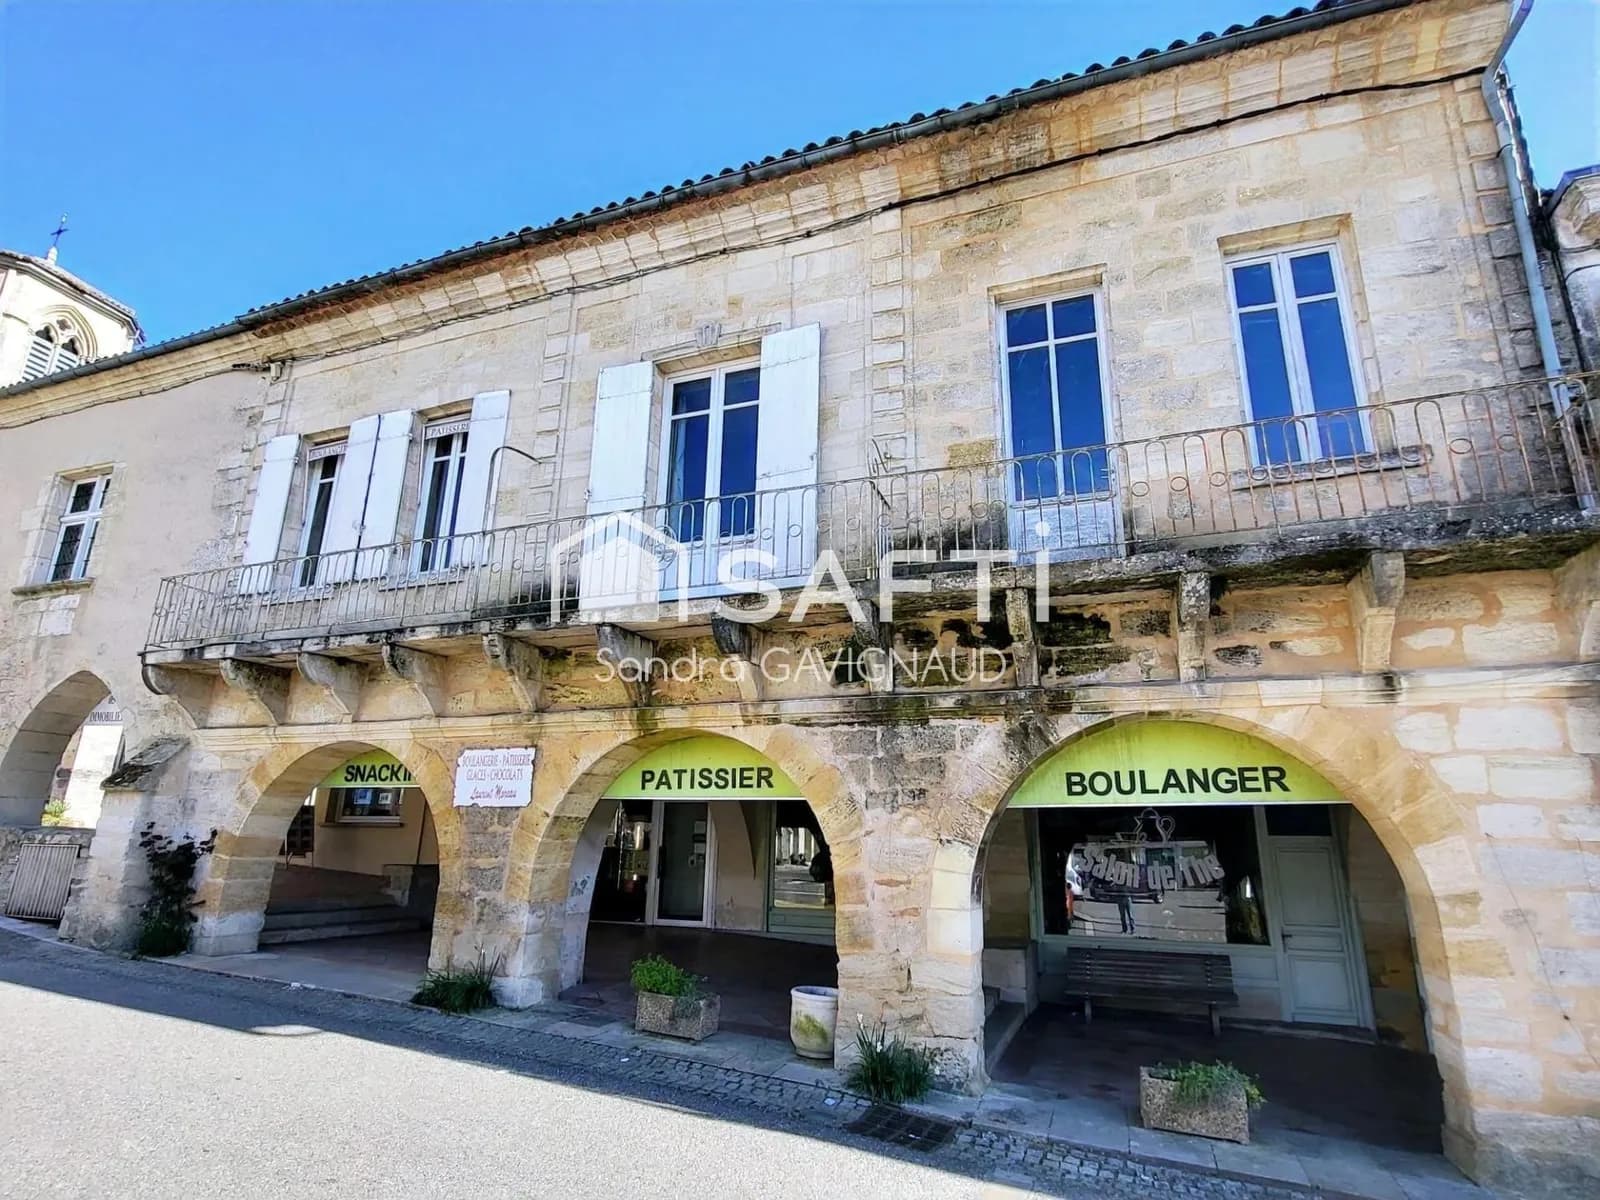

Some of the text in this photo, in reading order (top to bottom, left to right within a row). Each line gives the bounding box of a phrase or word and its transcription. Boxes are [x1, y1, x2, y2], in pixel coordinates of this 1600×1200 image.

[640, 766, 774, 791] PATISSIER
[1065, 766, 1291, 797] BOULANGER
[1079, 846, 1139, 889] Salon
[1147, 860, 1175, 890] de
